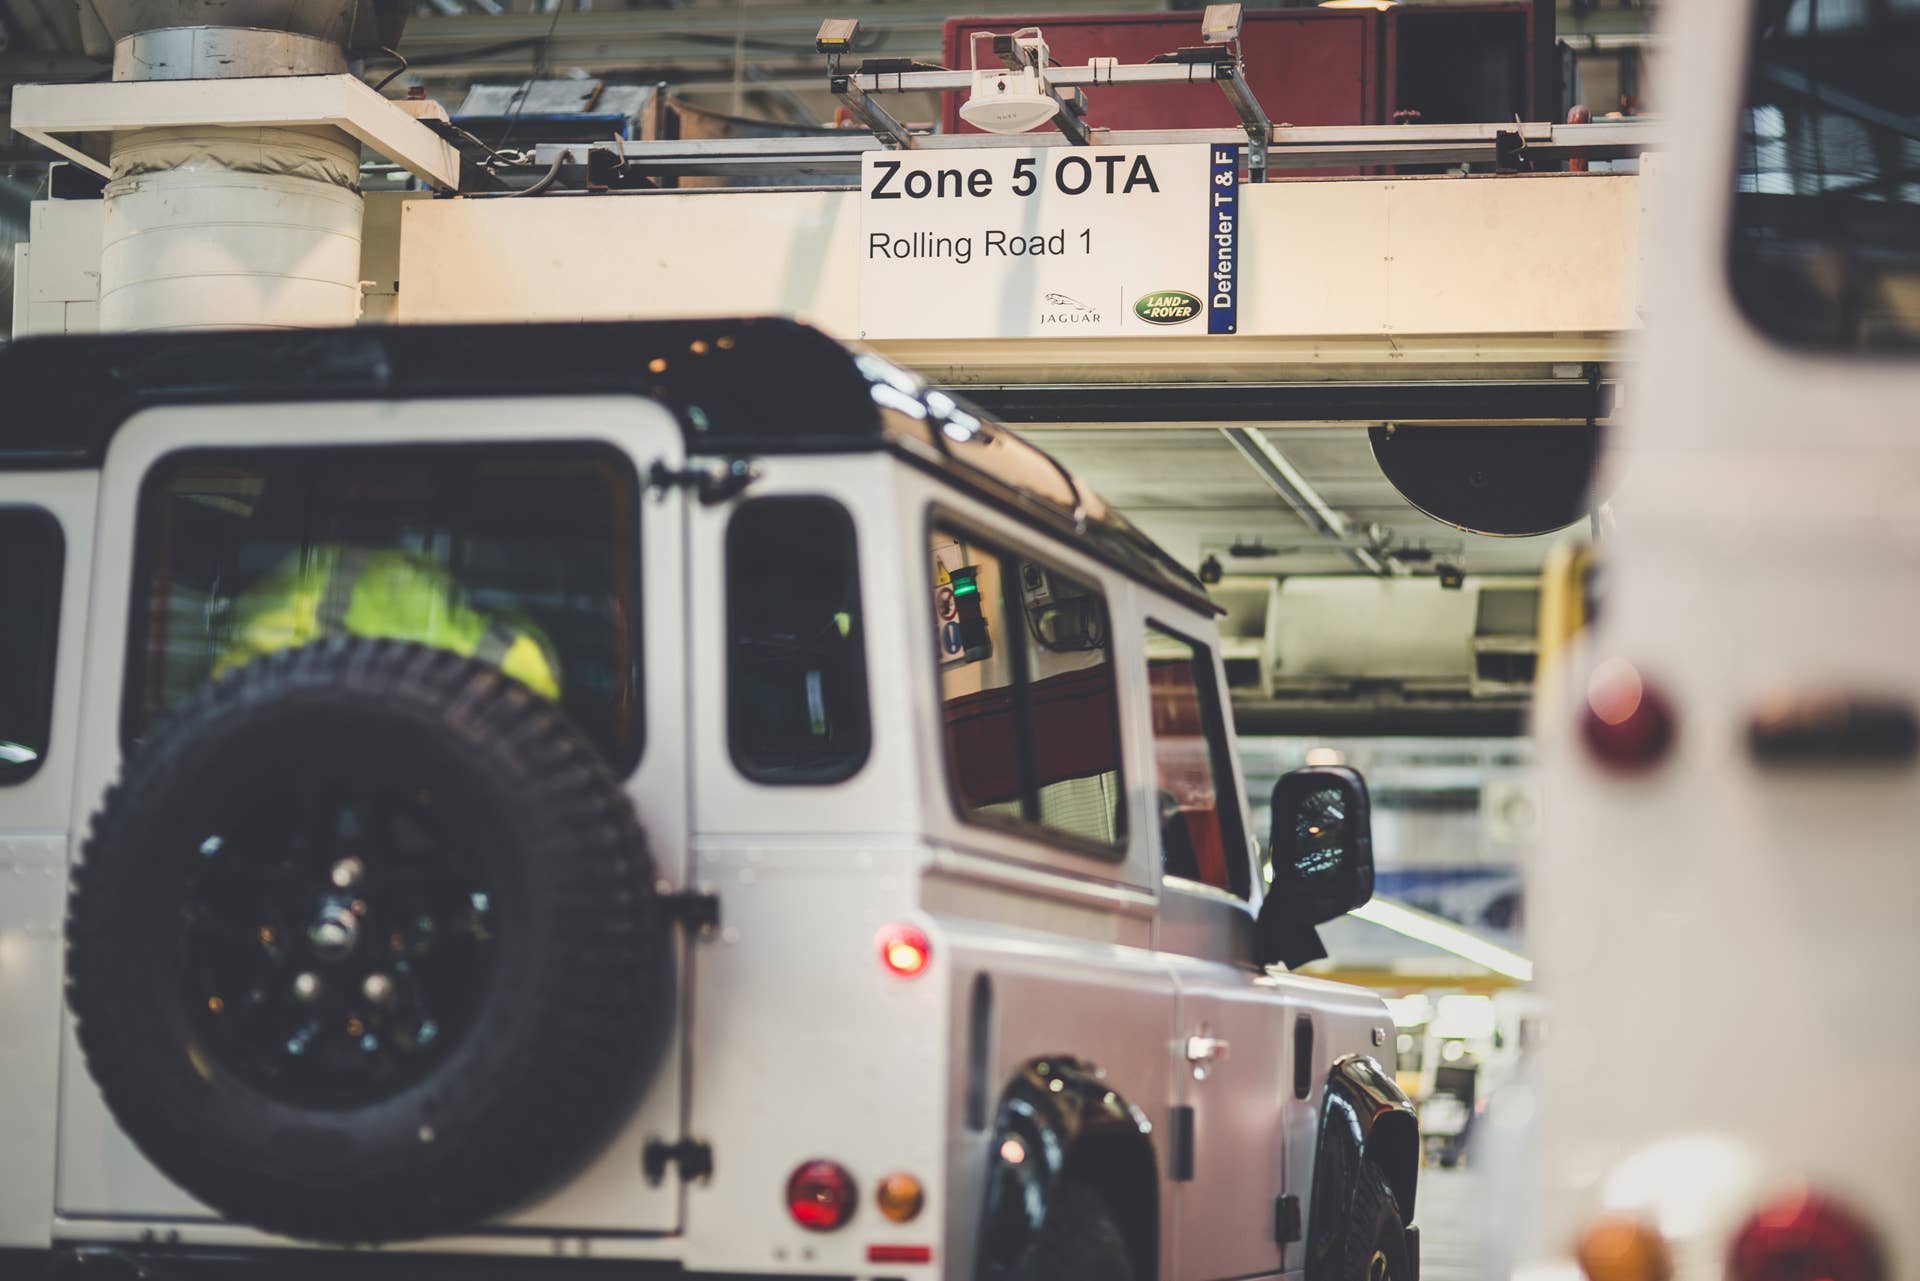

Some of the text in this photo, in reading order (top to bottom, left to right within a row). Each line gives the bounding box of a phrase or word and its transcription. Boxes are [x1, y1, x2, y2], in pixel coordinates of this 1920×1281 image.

[870, 154, 1160, 200] Zone 5 OTA
[1213, 151, 1233, 308] Defender T & F
[869, 227, 1092, 265] Rolling Road 1
[1146, 296, 1181, 308] LAND
[1150, 306, 1193, 318] ROVER
[1040, 313, 1101, 324] JAGUAR
